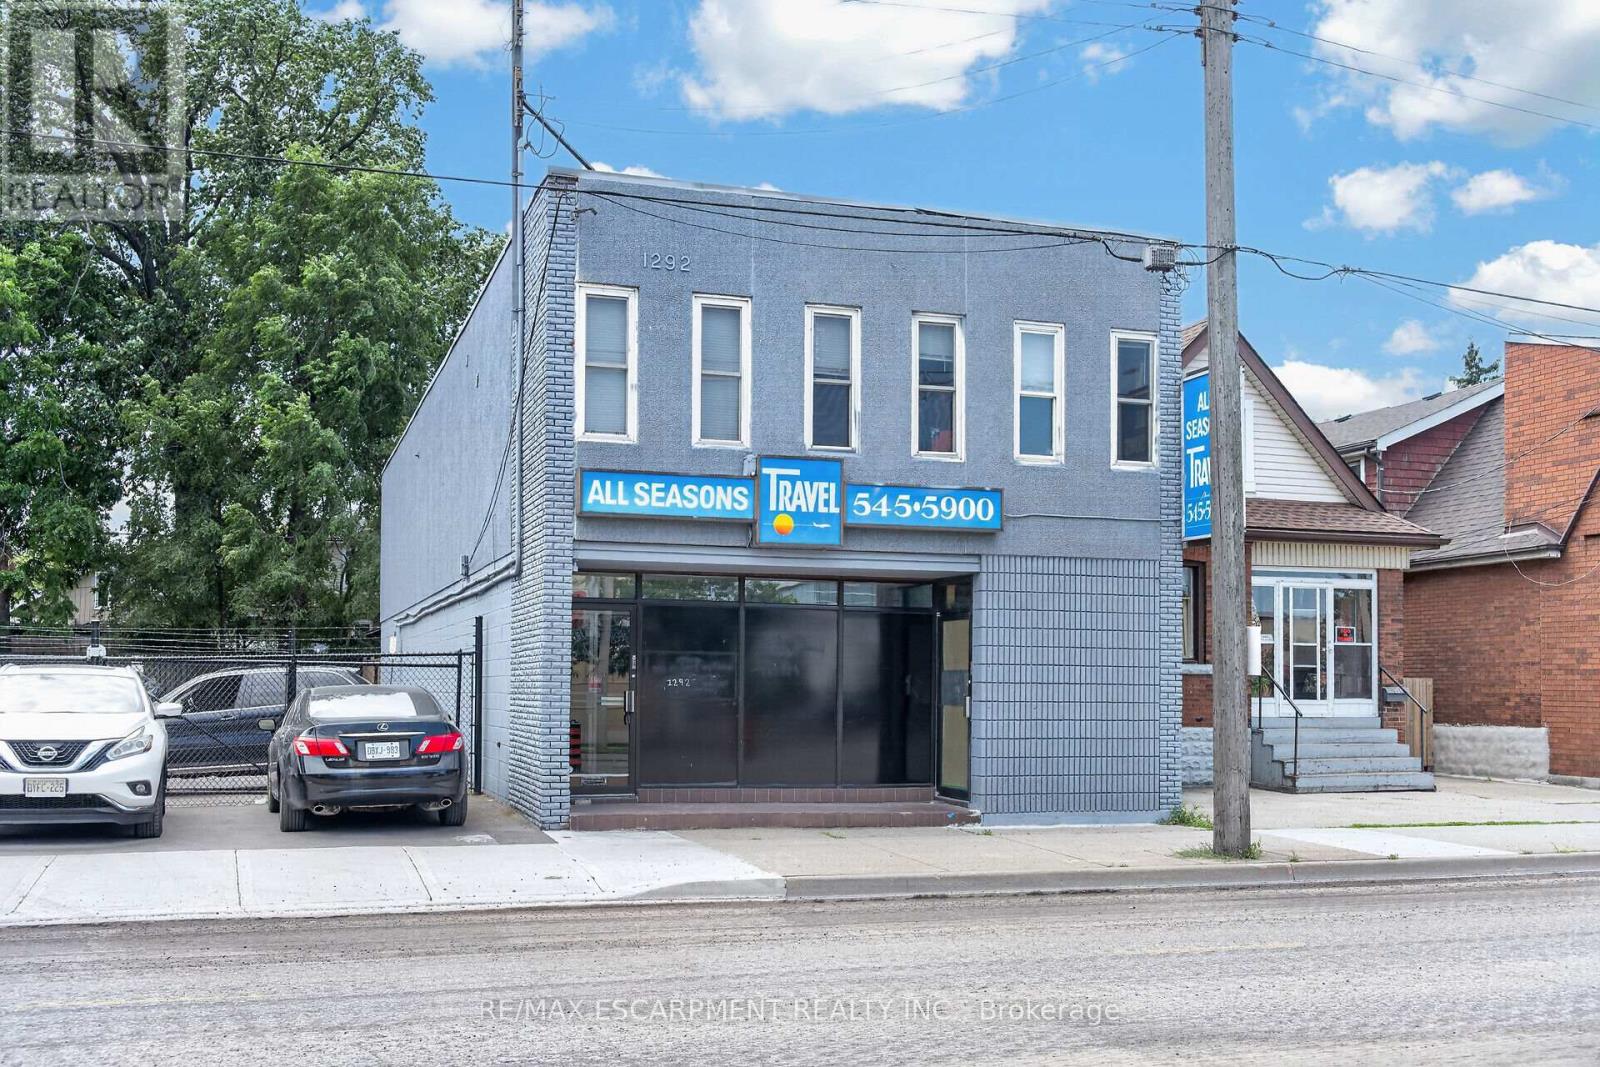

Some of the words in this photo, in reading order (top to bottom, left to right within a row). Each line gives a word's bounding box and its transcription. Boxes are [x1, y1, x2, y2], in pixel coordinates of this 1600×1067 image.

[643, 252, 690, 272] 1292
[1197, 391, 1210, 412] AL
[1186, 416, 1210, 440] SEAS
[587, 479, 630, 506] ALL
[634, 481, 749, 511] SEASONS
[762, 467, 840, 514] TRAVEL
[666, 678, 691, 687] 1292
